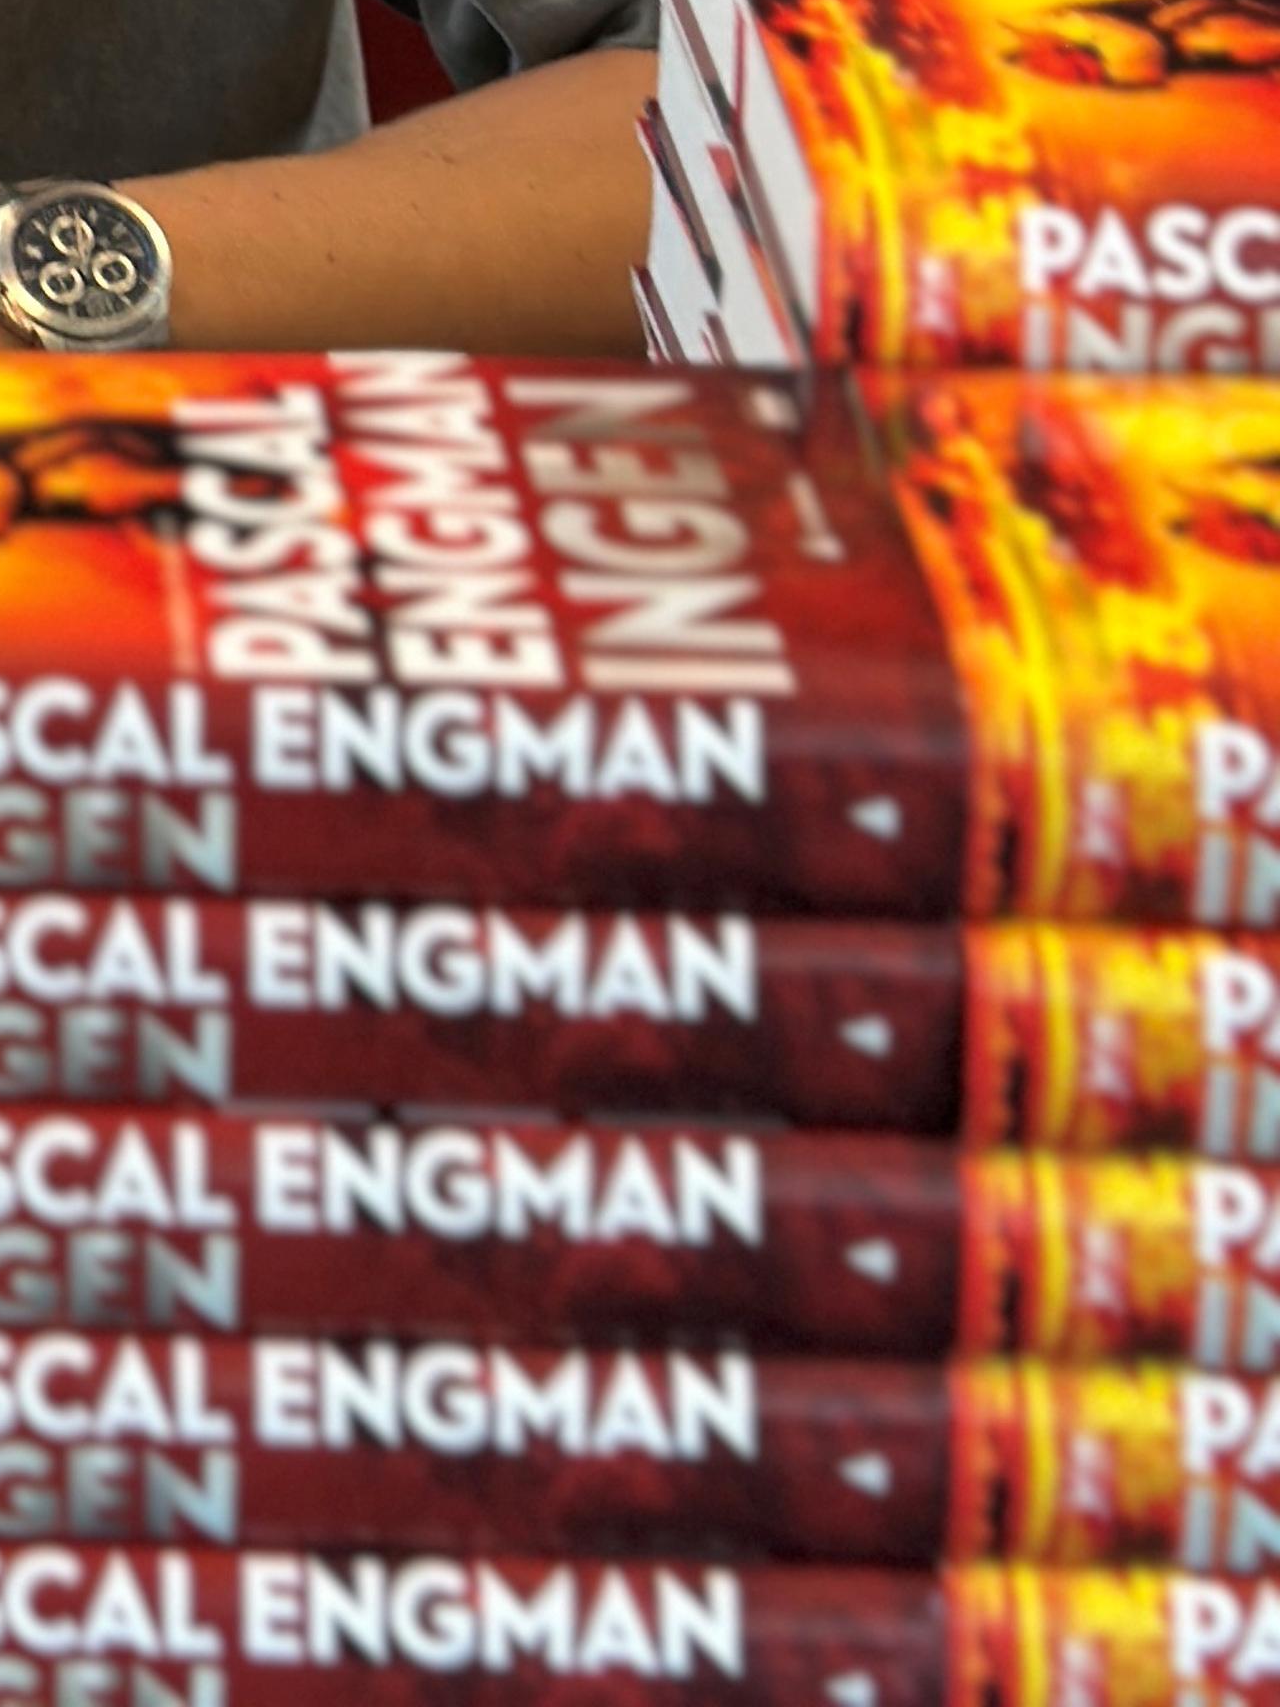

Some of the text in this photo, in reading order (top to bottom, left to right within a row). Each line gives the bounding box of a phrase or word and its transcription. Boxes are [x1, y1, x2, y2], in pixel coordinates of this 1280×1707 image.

[1020, 203, 1280, 301] PASC
[1024, 302, 1280, 375] ING
[170, 384, 380, 682] PASCAL
[326, 350, 566, 688] ENGMAN
[504, 378, 796, 696] INGEN
[253, 687, 765, 800] ENGMAN
[247, 902, 757, 1022] ENGMAN
[255, 1123, 761, 1246] ENGMAN
[254, 1339, 759, 1460] ENGMAN
[242, 1555, 746, 1677] ENGMAN
